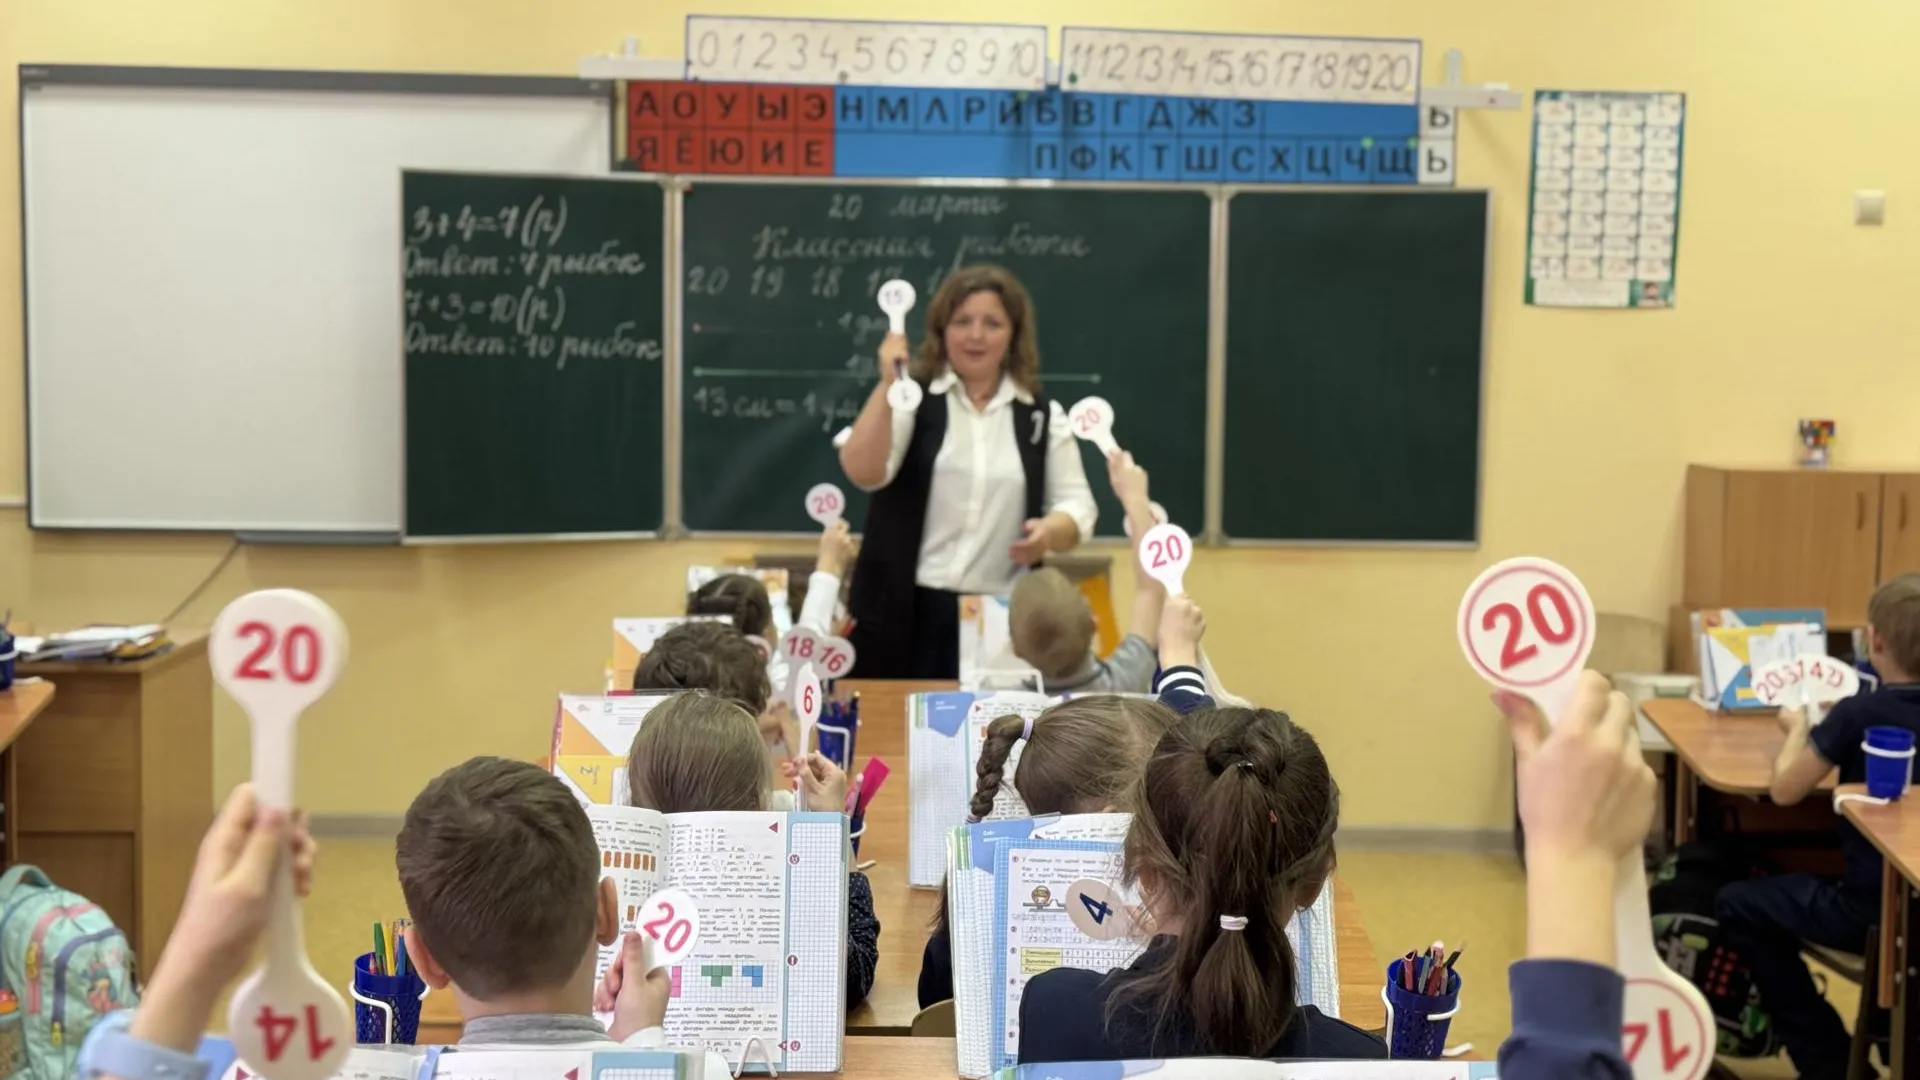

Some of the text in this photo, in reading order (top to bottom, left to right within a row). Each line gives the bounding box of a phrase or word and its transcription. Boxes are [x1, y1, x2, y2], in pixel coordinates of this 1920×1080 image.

[698, 30, 1038, 77] 0 1 2 3 4 5 6 7 8 9 10
[1100, 43, 1130, 80] 12
[1135, 44, 1165, 82] 13
[1169, 47, 1198, 83] 14
[1204, 49, 1235, 86] 15
[1240, 48, 1269, 87] 16
[1274, 51, 1306, 88] 17
[1310, 51, 1340, 90] 18
[1341, 51, 1372, 91] 19
[1371, 53, 1413, 92] 20
[635, 90, 660, 118] А
[672, 90, 698, 119] О
[717, 92, 739, 121] У
[757, 92, 789, 121] Ы
[803, 92, 829, 122] Э
[840, 94, 865, 123] Н
[876, 95, 910, 124] М
[924, 96, 951, 124] Л
[964, 96, 987, 125] Р
[1037, 96, 1059, 126] Б
[1072, 99, 1096, 126] В
[1113, 99, 1131, 126] Г
[1186, 99, 1220, 128] Ж
[636, 135, 658, 163] Я
[709, 137, 745, 166] Ю
[760, 139, 784, 167] И
[804, 140, 826, 168] Е
[1036, 144, 1059, 170] П
[1070, 144, 1098, 173] Ф
[1110, 144, 1133, 172] К
[1151, 144, 1170, 173] Т
[1185, 145, 1219, 174] Ш
[1231, 146, 1255, 175] С
[1270, 146, 1291, 175] Х
[1306, 147, 1333, 178] Ц
[1345, 147, 1367, 175] Ч
[1378, 147, 1415, 178] Щ
[828, 193, 862, 221] 20
[687, 265, 730, 296] 20
[750, 264, 785, 299] 19
[810, 264, 843, 299] 18
[692, 385, 729, 418] 13
[1075, 407, 1101, 433] 20
[813, 492, 839, 515] 20
[1147, 533, 1184, 569] 20
[1480, 582, 1576, 672] 20
[232, 619, 322, 684] 20
[786, 634, 815, 659] 18
[818, 645, 847, 673] 16
[802, 684, 814, 715] 6
[1078, 892, 1114, 925] 4
[642, 901, 693, 954] 20
[254, 1002, 337, 1063] 14
